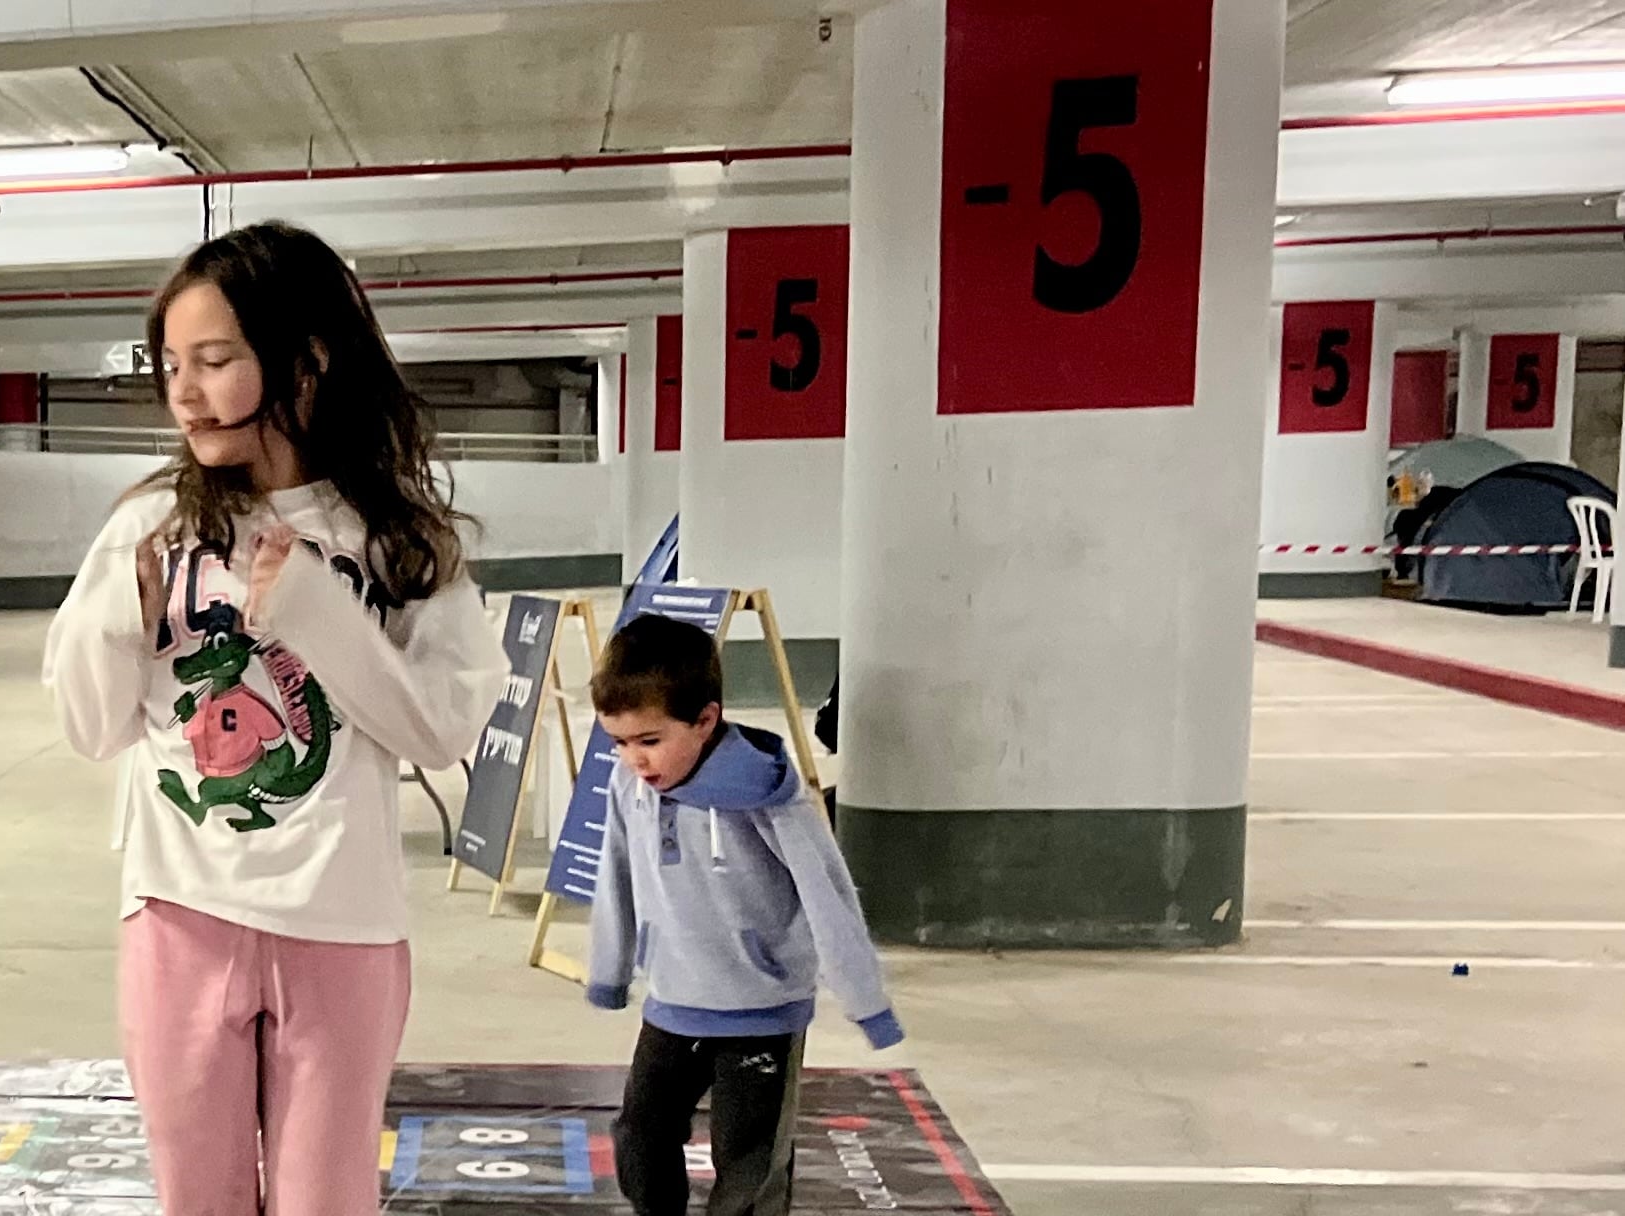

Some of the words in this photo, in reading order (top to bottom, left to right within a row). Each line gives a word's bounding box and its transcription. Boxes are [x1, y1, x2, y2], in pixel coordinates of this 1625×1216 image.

[963, 74, 1143, 315] -5
[735, 278, 821, 392] -5
[1287, 328, 1351, 407] -5
[220, 707, 237, 732] C
[459, 1127, 529, 1144] 8
[456, 1161, 530, 1178] 9
